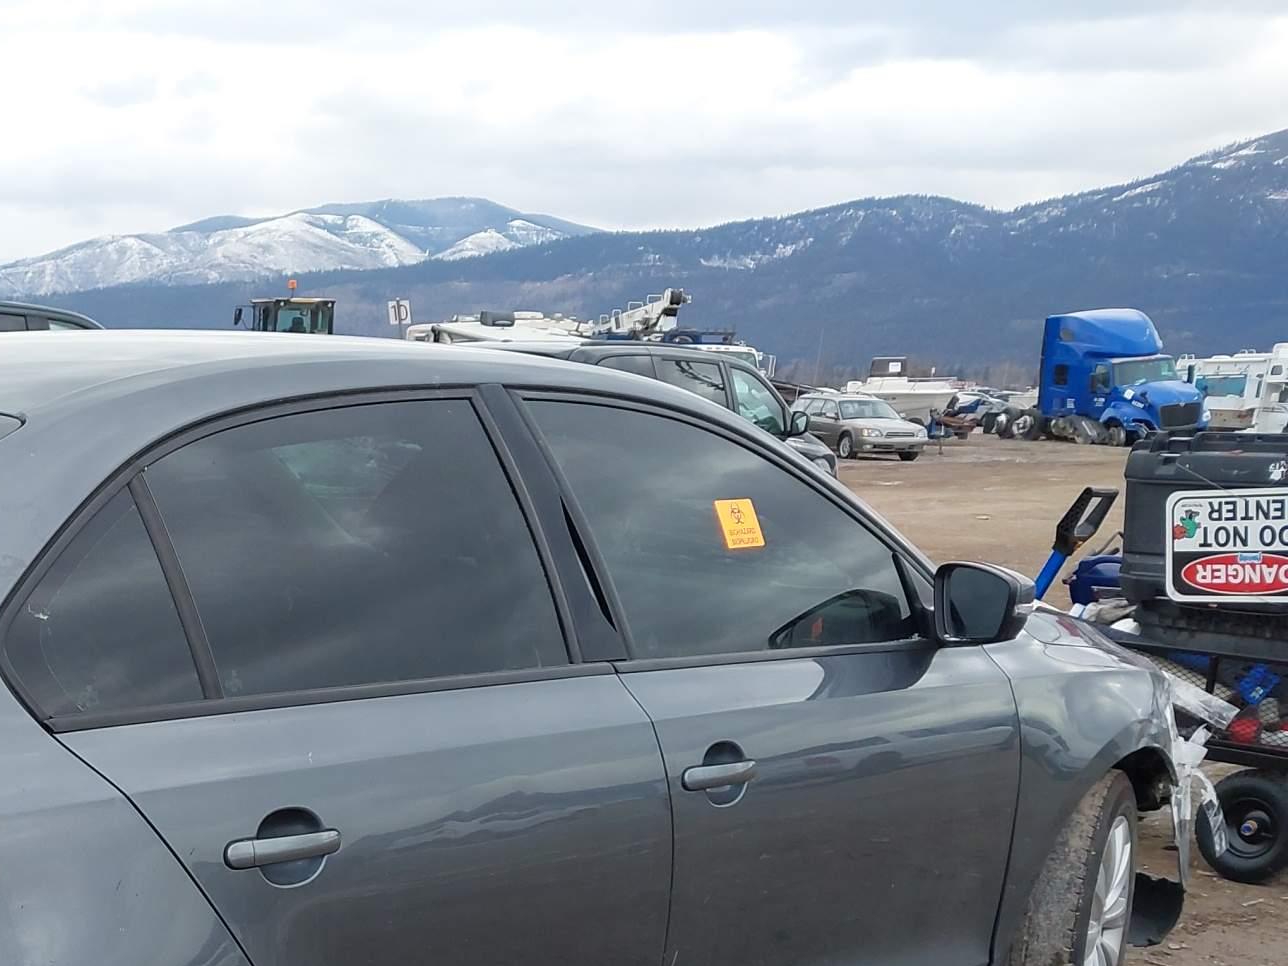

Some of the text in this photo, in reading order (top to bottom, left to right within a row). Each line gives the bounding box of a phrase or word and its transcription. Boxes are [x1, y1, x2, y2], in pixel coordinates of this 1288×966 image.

[1208, 499, 1285, 522] ENTER
[1199, 525, 1249, 548] NOT
[1196, 564, 1288, 585] DANGER
